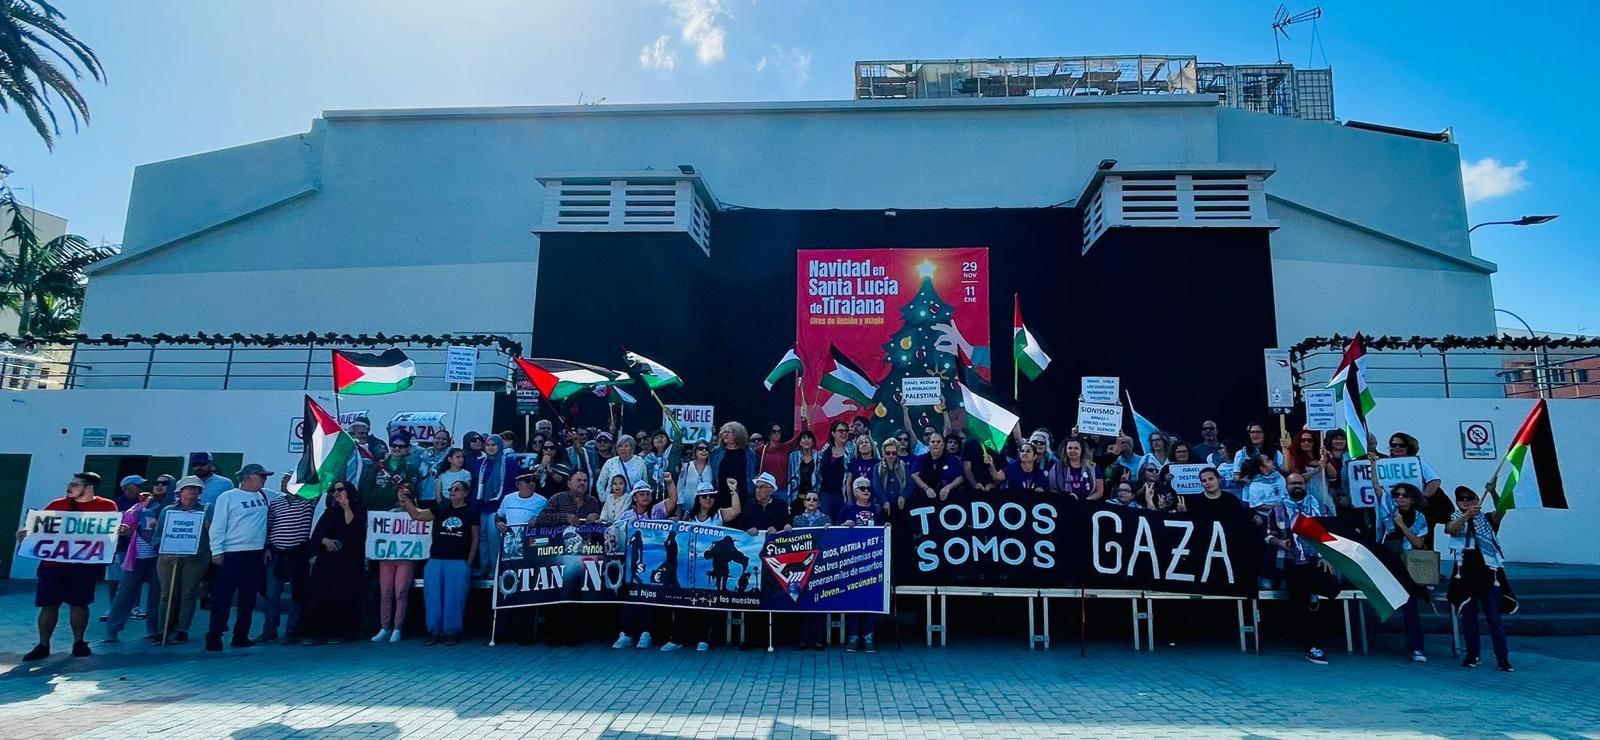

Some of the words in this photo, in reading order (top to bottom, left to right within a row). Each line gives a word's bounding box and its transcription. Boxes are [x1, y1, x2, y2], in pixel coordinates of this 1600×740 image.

[809, 259, 871, 278] Navidad
[872, 266, 885, 277] en
[962, 261, 978, 272] 29
[808, 278, 853, 296] Santa
[856, 276, 899, 295] Lucía
[965, 285, 975, 296] 11
[810, 302, 822, 314] de
[822, 296, 885, 316] Tirajana
[859, 318, 863, 326] y
[864, 317, 884, 326] magia
[683, 409, 711, 423] DUELE
[1080, 406, 1115, 415] SIONISMO
[1377, 462, 1418, 480] DUELE
[33, 515, 62, 534] ME
[64, 517, 119, 535] DUELE
[373, 517, 391, 534] ME
[392, 518, 430, 535] DUELE
[910, 502, 1058, 536] TODOS
[633, 521, 673, 531] OBJETIVOS
[693, 527, 725, 537] GUERRA
[775, 533, 813, 545] NTIFASCISTAS
[791, 540, 813, 552] Wolff
[822, 548, 839, 559] DIOS,
[839, 542, 862, 554] PATRIA
[862, 542, 867, 550] y
[867, 536, 880, 547] REY
[1092, 510, 1235, 584] GAZA
[32, 539, 105, 561] GAZA
[374, 538, 424, 559] GAZA
[537, 545, 564, 557] nunca
[567, 544, 579, 553] se
[582, 542, 604, 554] rinde
[917, 535, 1056, 572] SOMOS
[814, 564, 826, 575] Son
[826, 560, 839, 571] tres
[839, 552, 872, 569] pandemias
[871, 549, 884, 560] que
[499, 565, 566, 595] OTAN
[581, 559, 625, 592] NO
[808, 576, 834, 590] generan
[850, 567, 859, 576] de
[858, 560, 884, 574] muertos
[640, 589, 657, 599] hijos
[719, 595, 730, 603] los
[731, 597, 761, 605] nuestros
